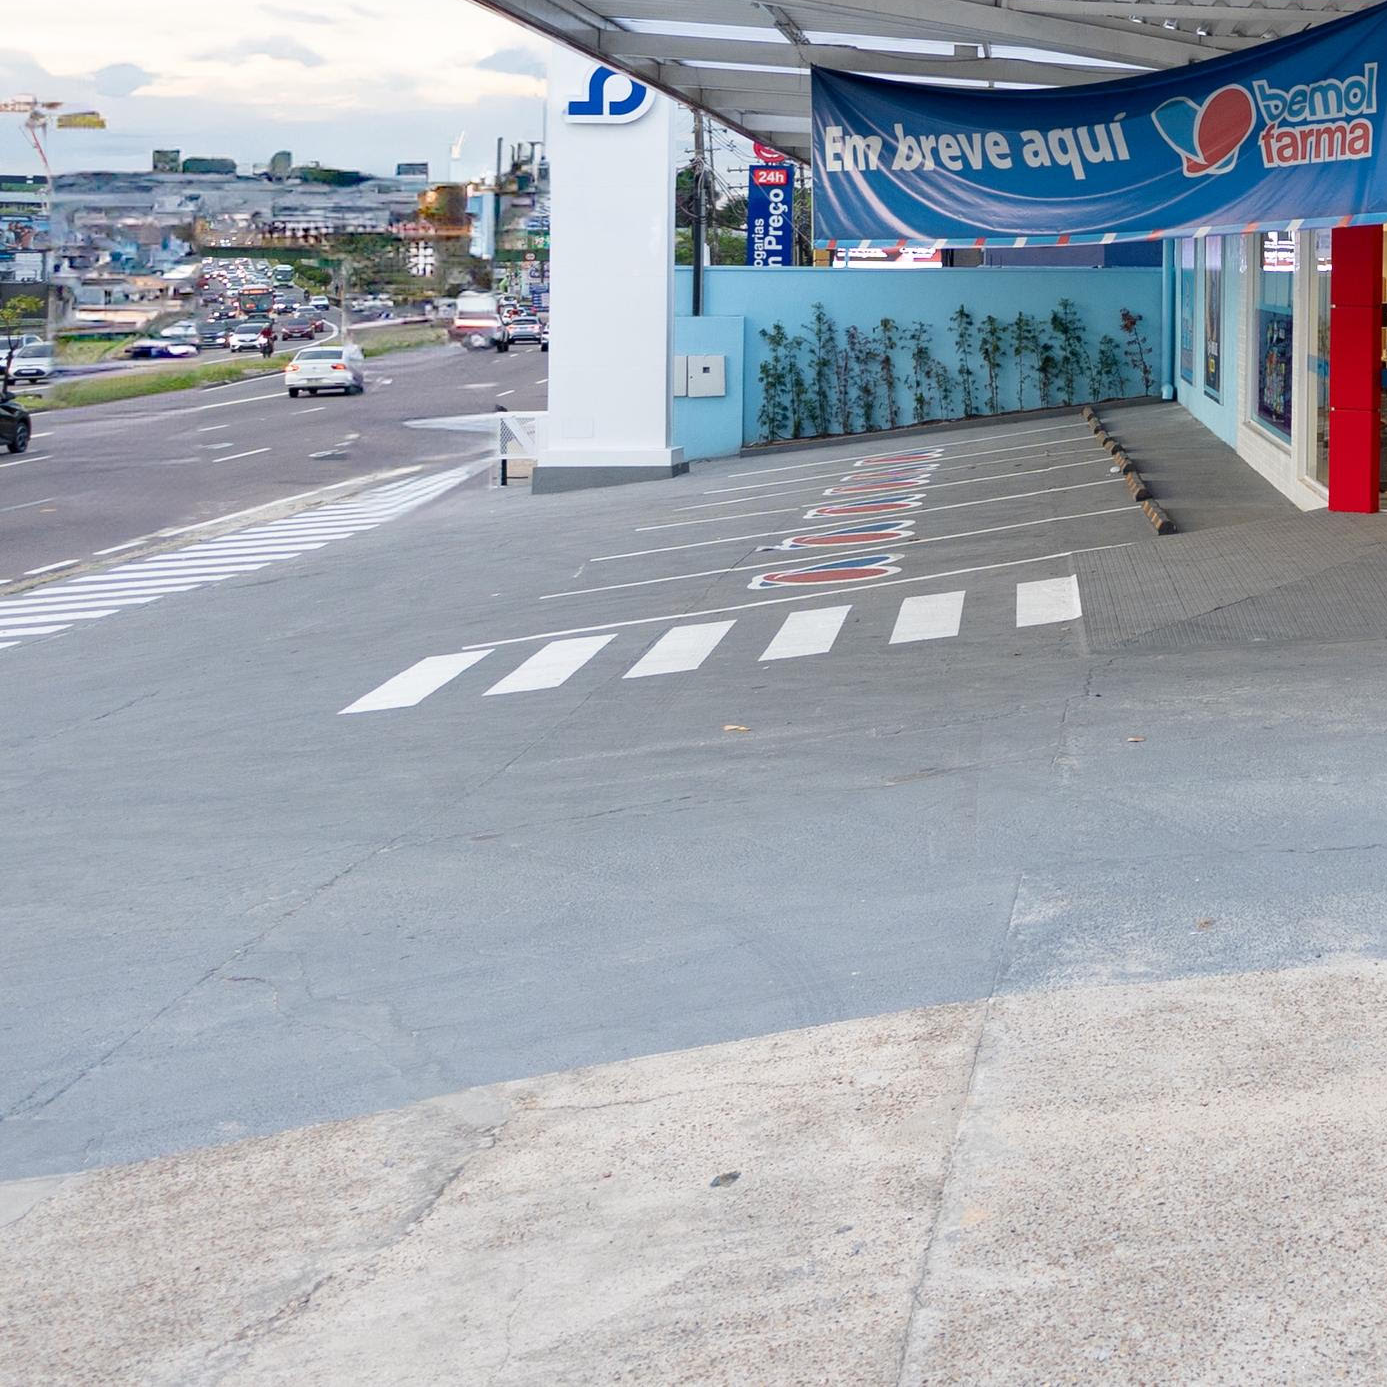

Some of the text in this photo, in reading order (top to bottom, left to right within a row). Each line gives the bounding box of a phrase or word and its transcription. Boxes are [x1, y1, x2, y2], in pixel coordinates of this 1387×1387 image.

[1252, 62, 1378, 124] bemol
[824, 125, 883, 173] Em
[891, 123, 1013, 172] breve
[1258, 118, 1373, 168] farma
[758, 171, 785, 184] 24h
[752, 218, 767, 267] ogarias
[764, 188, 788, 250] Preço
